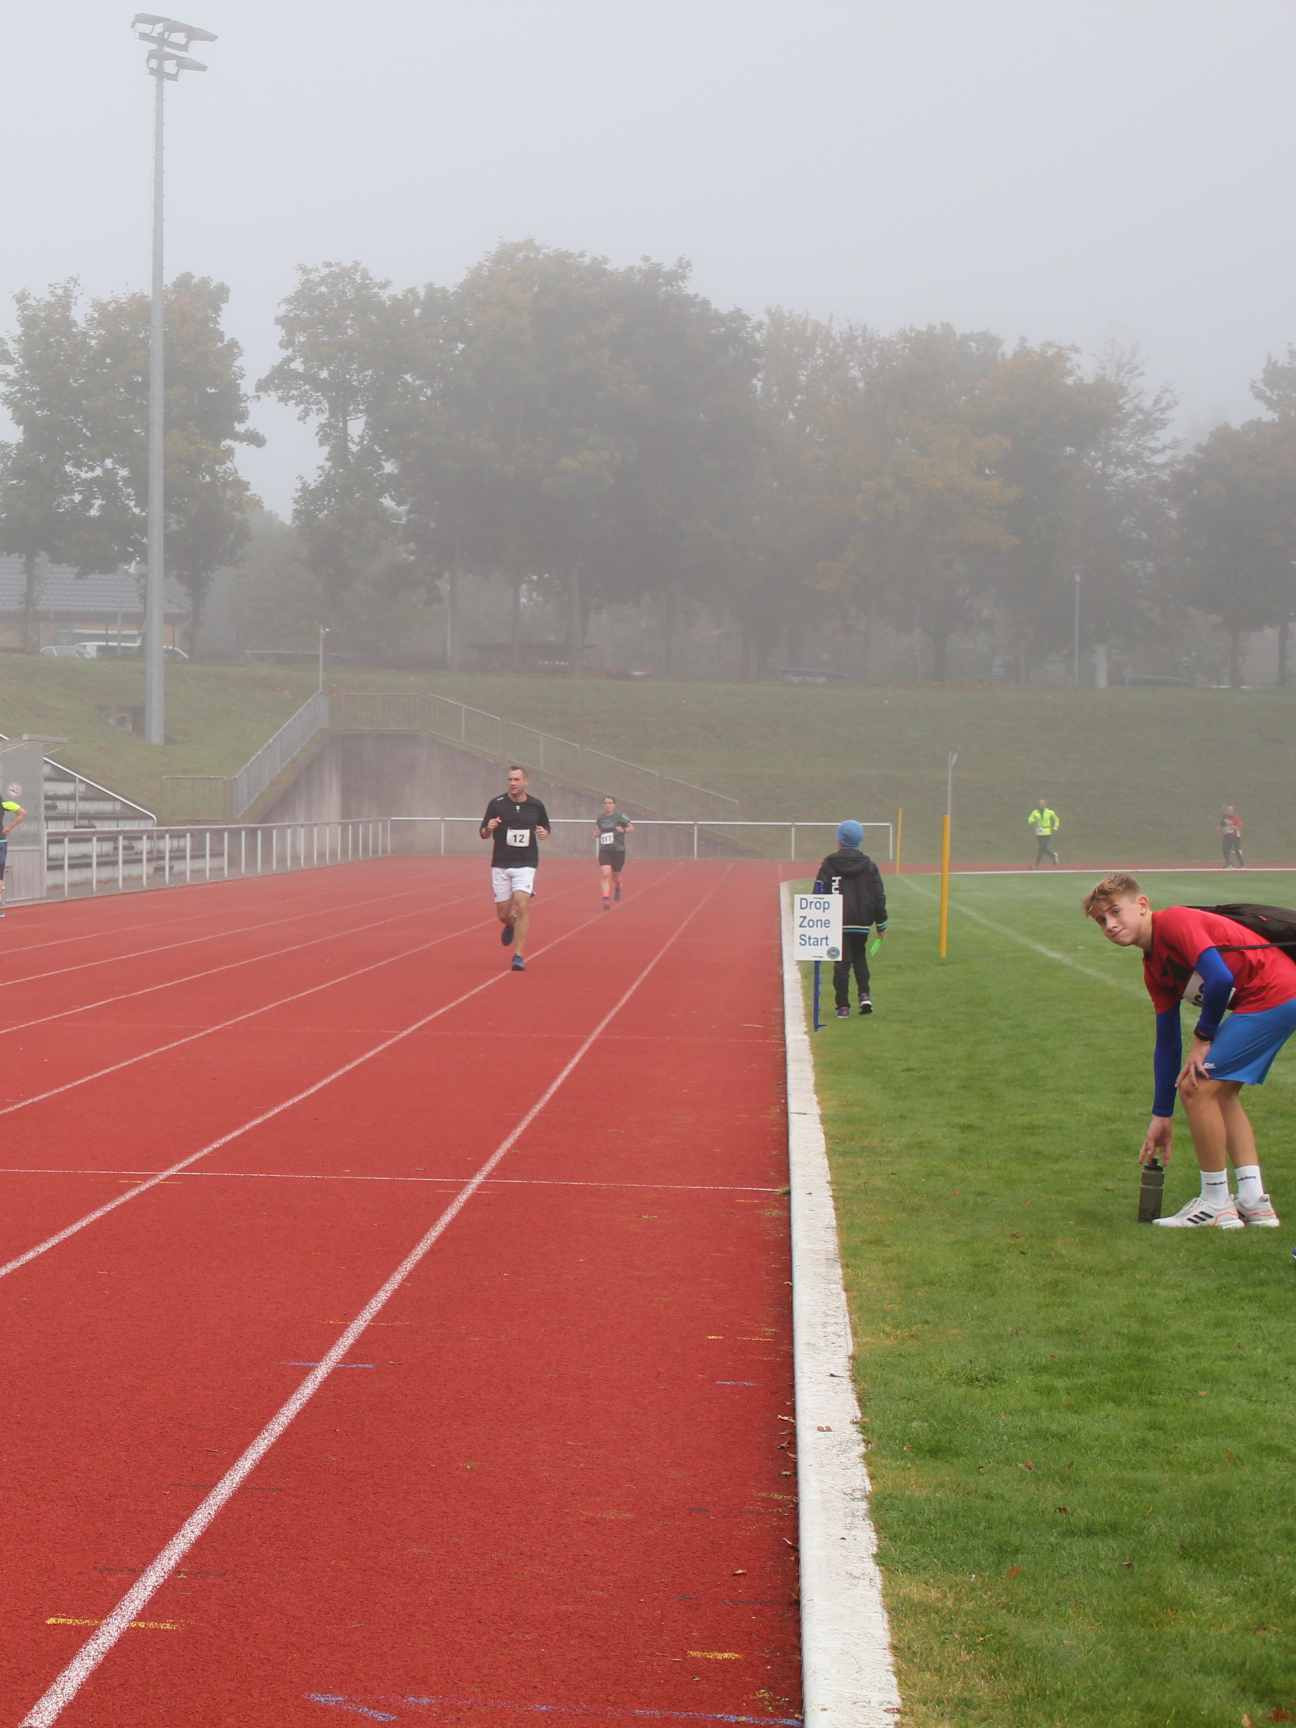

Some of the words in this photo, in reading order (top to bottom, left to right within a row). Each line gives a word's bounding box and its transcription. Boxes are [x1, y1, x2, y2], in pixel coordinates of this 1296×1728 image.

[512, 833, 525, 844] 12
[799, 898, 831, 912] Drop
[799, 915, 831, 929] Zone
[799, 934, 830, 947] Start
